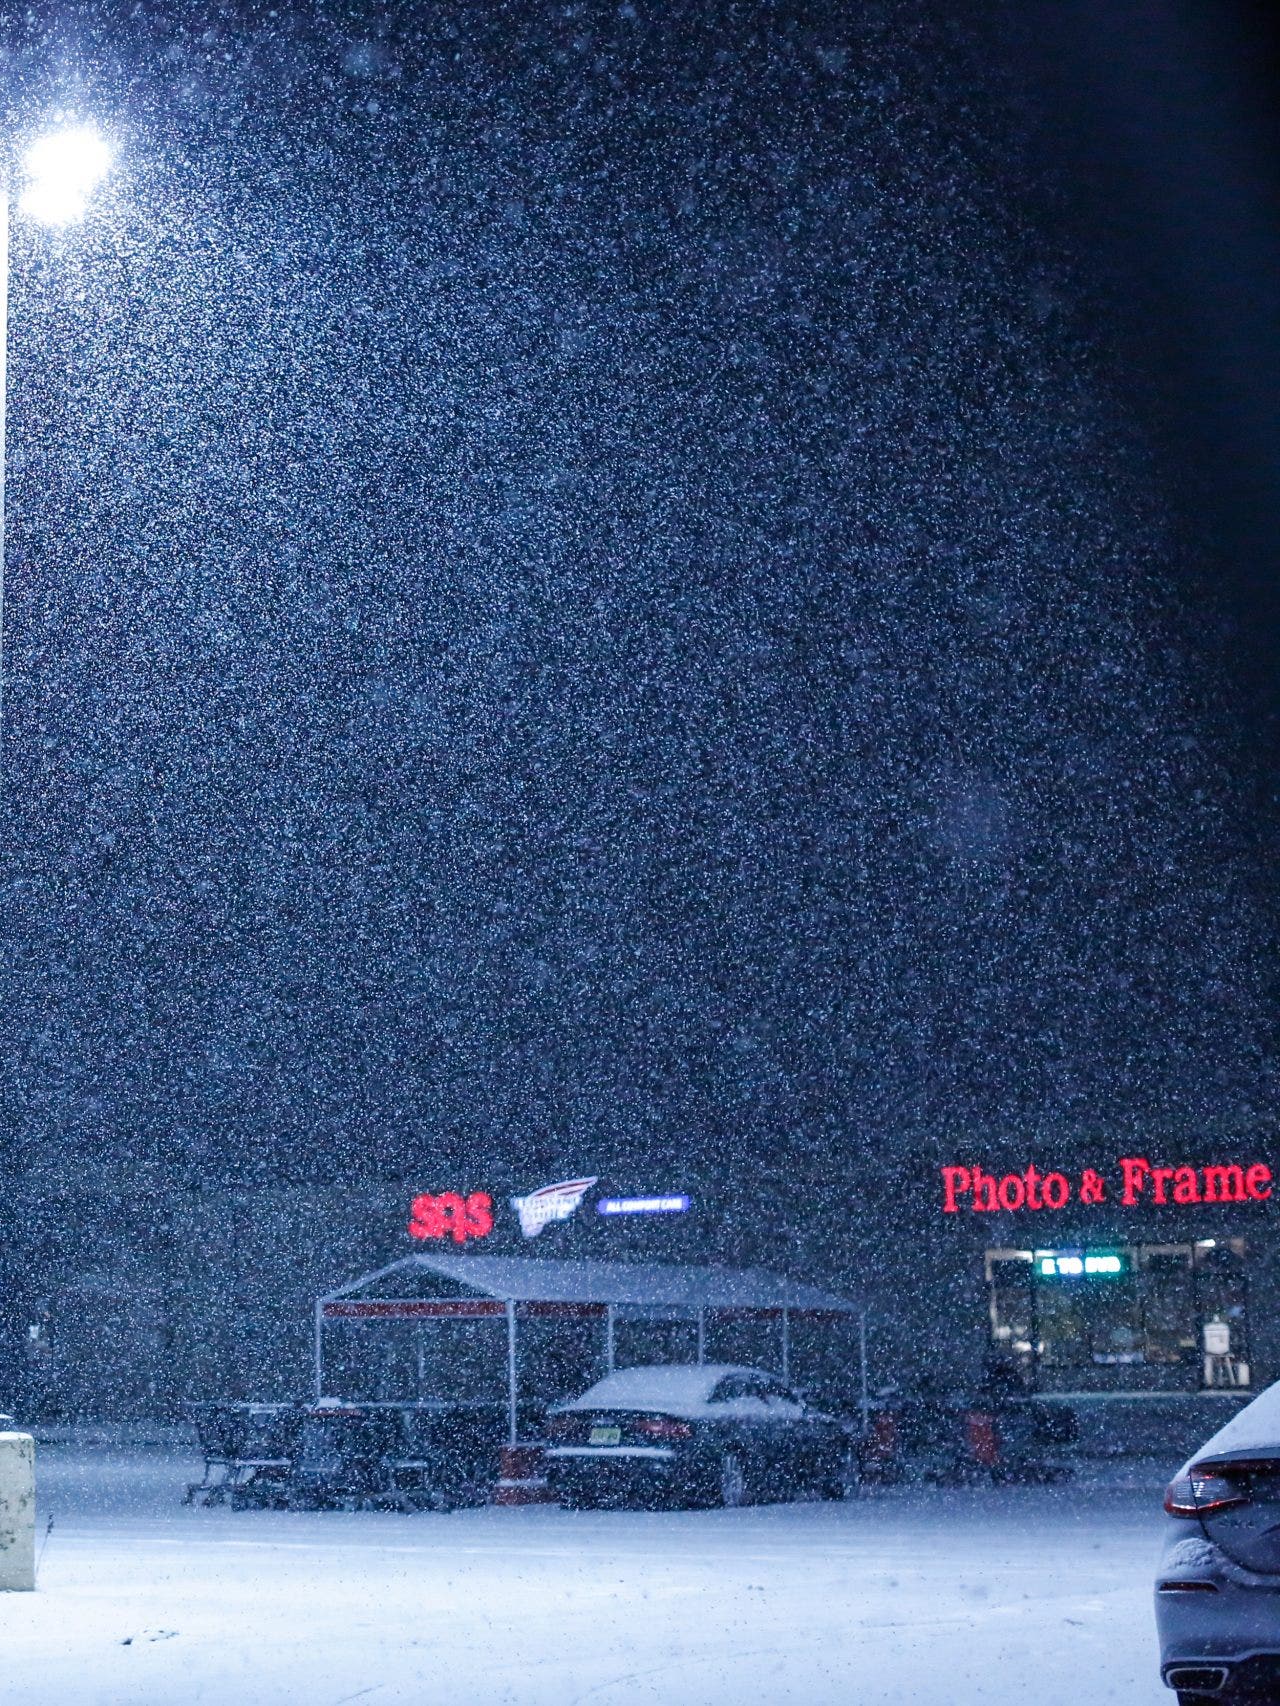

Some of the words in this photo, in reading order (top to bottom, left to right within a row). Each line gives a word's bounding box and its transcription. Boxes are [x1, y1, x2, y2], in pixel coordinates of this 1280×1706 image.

[941, 1163, 1069, 1213] Photo
[1079, 1168, 1105, 1204] &
[1120, 1157, 1272, 1206] Frame
